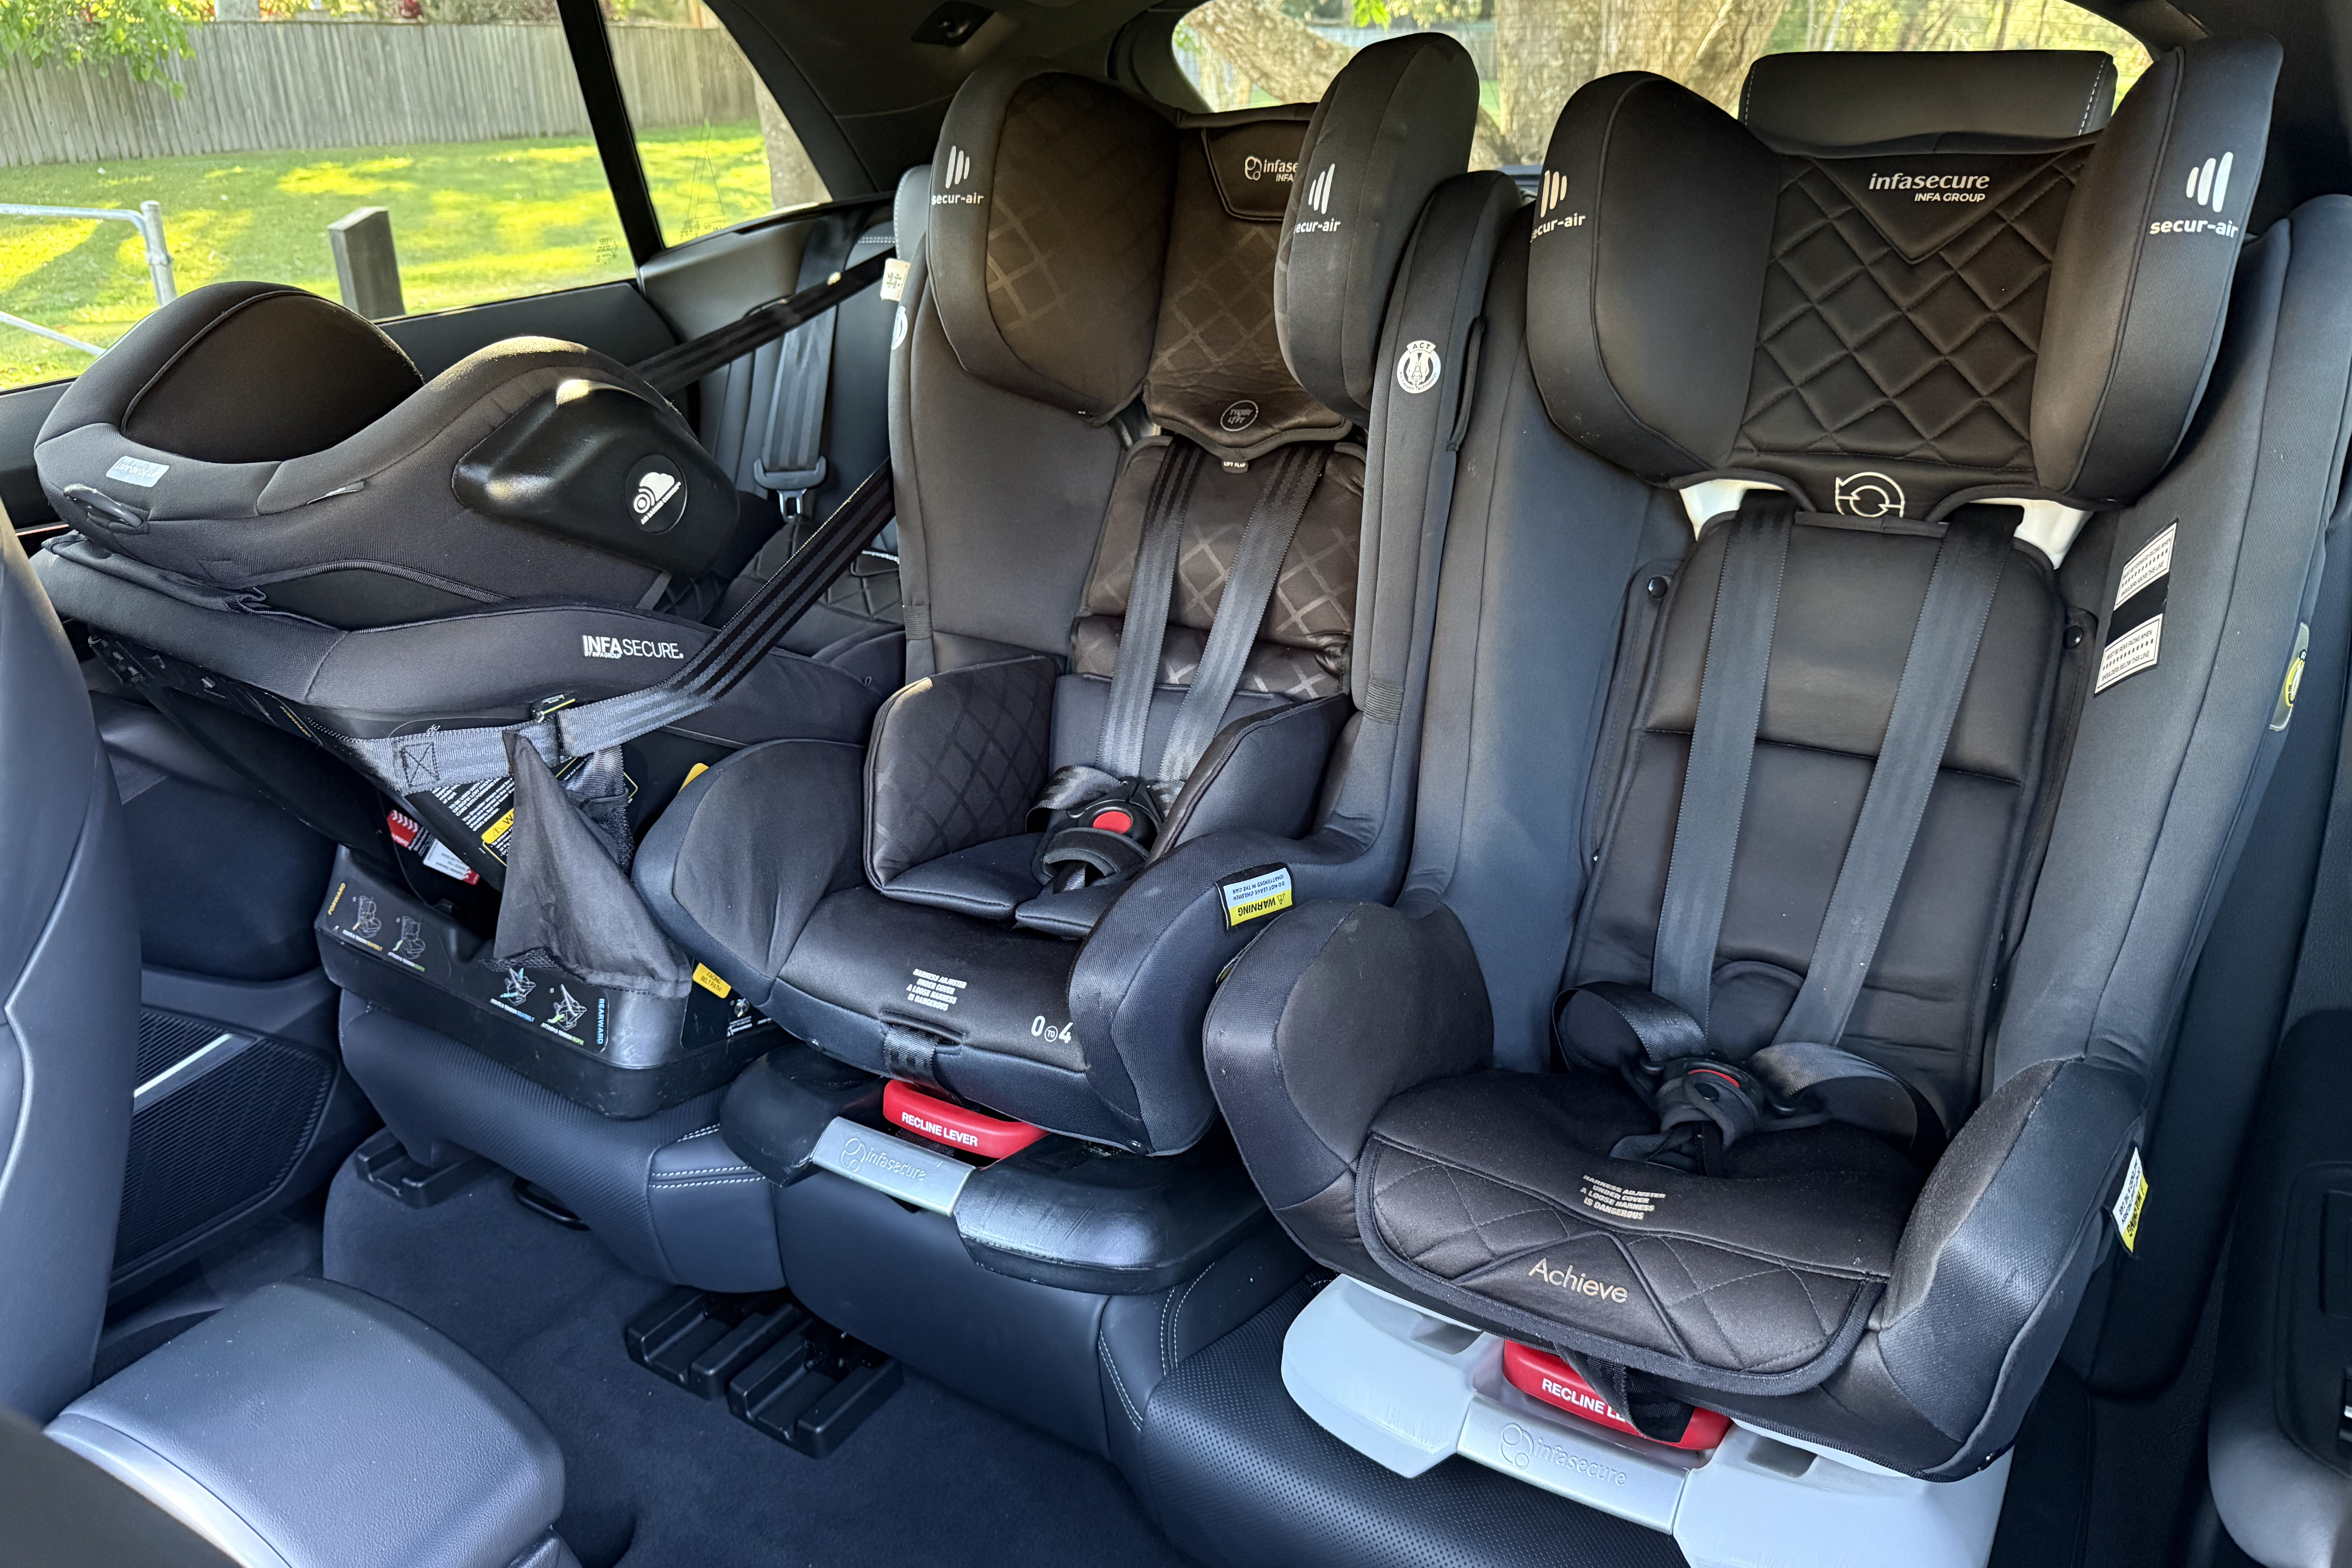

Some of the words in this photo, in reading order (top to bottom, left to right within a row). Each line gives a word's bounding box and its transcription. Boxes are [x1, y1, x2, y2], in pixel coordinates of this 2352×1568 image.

[1263, 159, 1298, 173] infase
[1869, 173, 1990, 189] infasecure
[931, 192, 984, 205] secur-air
[1914, 193, 1941, 202] INFA
[1943, 193, 1986, 202] GROUP
[1530, 212, 1585, 243] ecur-air
[2149, 220, 2238, 238] secur-air
[2140, 651, 2150, 660] LINE
[1257, 875, 1284, 887] UNATTENDED
[1233, 891, 1254, 901] CHILDREN
[1255, 887, 1268, 895] LEAVE
[1238, 897, 1276, 916] WARNING
[700, 975, 711, 985] BELT
[710, 982, 722, 992] PATH
[706, 972, 721, 984] FACING
[913, 968, 940, 981] HARNESS
[938, 976, 967, 989] ADJUSTER
[917, 978, 936, 989] UNDER
[936, 984, 955, 995] COVER
[908, 993, 915, 1001] IS
[914, 995, 949, 1011] DANGEROUS
[912, 985, 931, 996] LOOSE
[930, 991, 957, 1004] HARNESS
[1031, 1015, 1045, 1036] 0
[1059, 1022, 1073, 1043] 4
[902, 1111, 942, 1136] RECLINE
[943, 1127, 978, 1147] LEVER
[865, 1147, 926, 1181] infasecure
[1583, 1175, 1622, 1192] HARNESS
[1622, 1189, 1666, 1198] ADJUSTER
[1592, 1185, 1621, 1200] UNDER
[1583, 1197, 1594, 1206] IS
[1593, 1201, 1644, 1220] DANGEROUS
[1588, 1190, 1615, 1205] LOOSE
[1615, 1201, 1655, 1212] HARNESS
[1528, 1258, 1628, 1303] Achieve
[1542, 1378, 1605, 1413] RECLINE
[1534, 1437, 1626, 1486] infasecure
